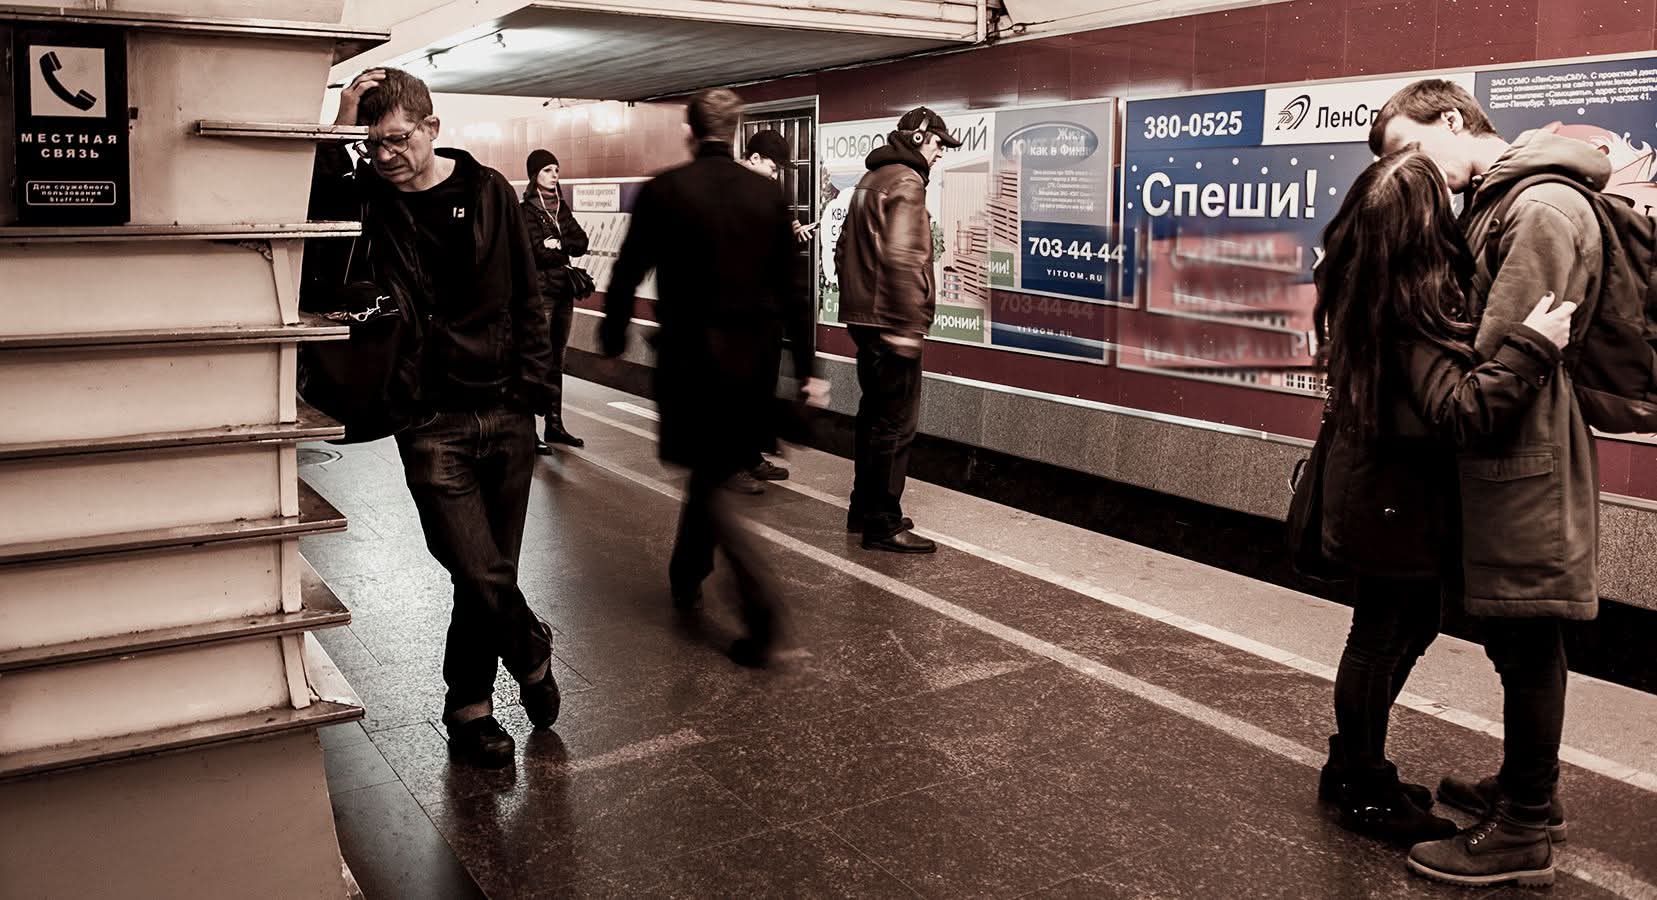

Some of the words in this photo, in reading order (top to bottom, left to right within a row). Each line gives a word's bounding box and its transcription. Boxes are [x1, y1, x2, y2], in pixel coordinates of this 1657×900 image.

[1639, 92, 1652, 101] 41.
[1143, 110, 1243, 140] 380-0525
[21, 132, 118, 145] МЕСТНАЯ
[41, 147, 100, 159] СВЯЗЬ
[32, 183, 51, 191] Для
[75, 196, 95, 204] only
[1142, 169, 1318, 219] Спеши!
[1028, 236, 1126, 264] 703-44-44
[1046, 268, 1103, 282] YITDOM.RU
